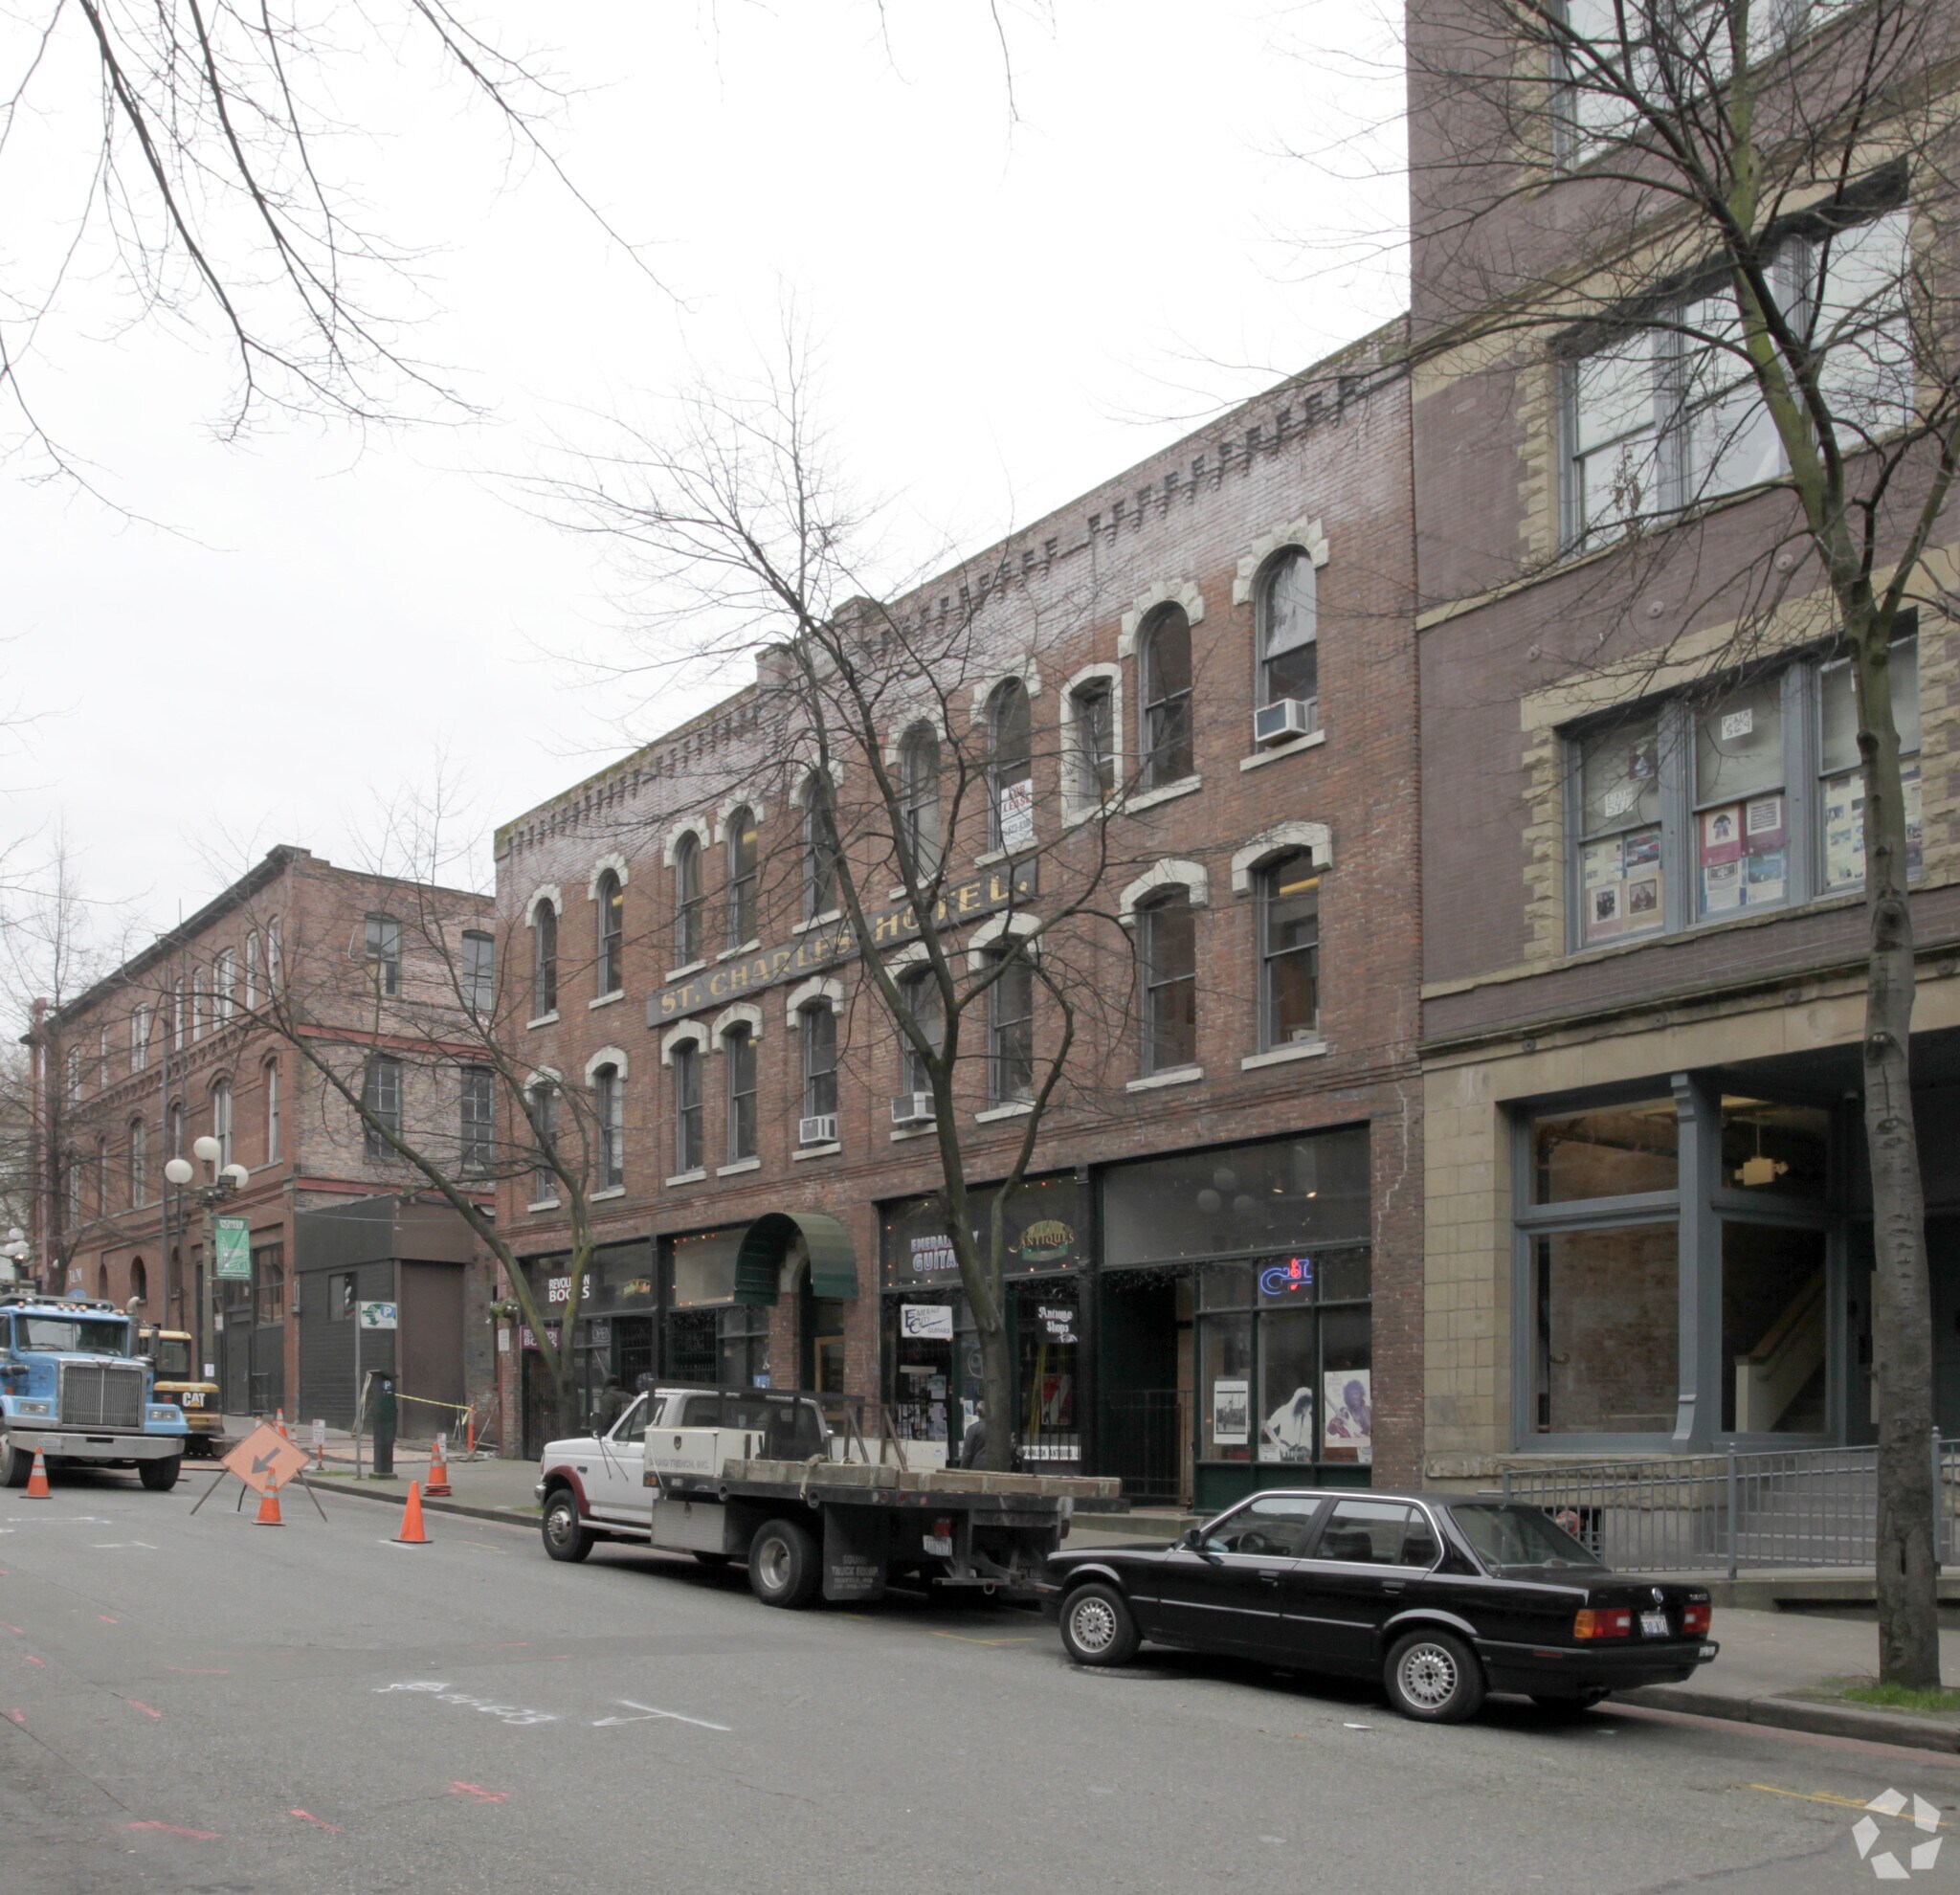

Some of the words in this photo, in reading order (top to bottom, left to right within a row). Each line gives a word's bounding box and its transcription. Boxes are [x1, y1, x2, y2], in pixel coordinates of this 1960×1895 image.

[661, 985, 702, 1014] ST.
[710, 928, 853, 996] CHARLES
[911, 1235, 953, 1253] EMERAL
[1019, 1232, 1076, 1250] ANTIQUES
[912, 1249, 959, 1272] GUITA
[548, 1285, 590, 1303] BOOS
[1038, 1306, 1073, 1322] Antique
[1046, 1321, 1069, 1335] Shops
[182, 1392, 206, 1407] CAT
